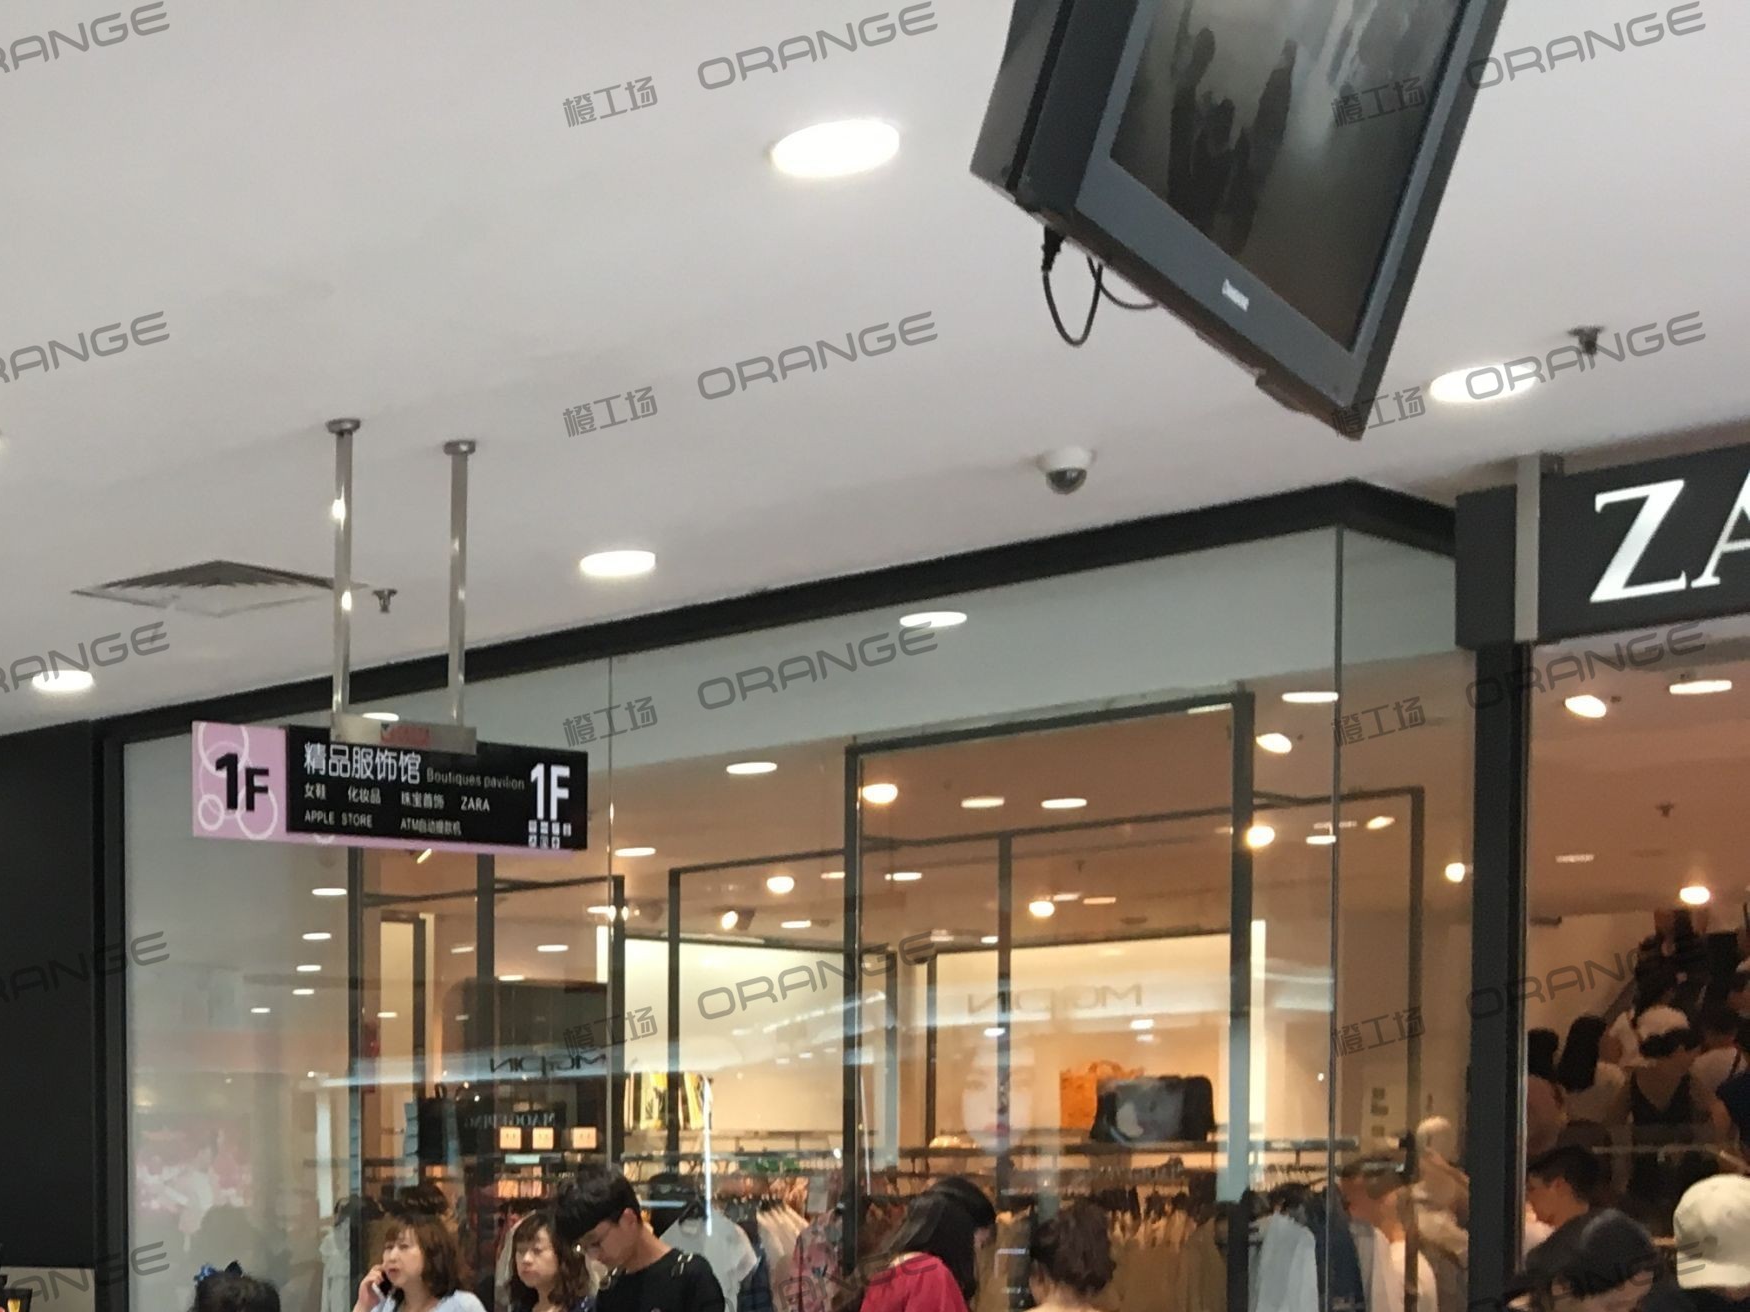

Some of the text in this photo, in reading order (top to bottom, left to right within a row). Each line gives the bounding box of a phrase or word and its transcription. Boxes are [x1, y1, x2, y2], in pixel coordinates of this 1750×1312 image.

[304, 743, 421, 784] 精品服饰馆
[426, 767, 525, 791] Boutiques pavilion
[214, 752, 269, 811] 1F
[530, 763, 571, 820] 1F
[347, 786, 382, 805] 化妆品
[460, 796, 491, 812] ZARA
[304, 810, 373, 829] APPLE STORE
